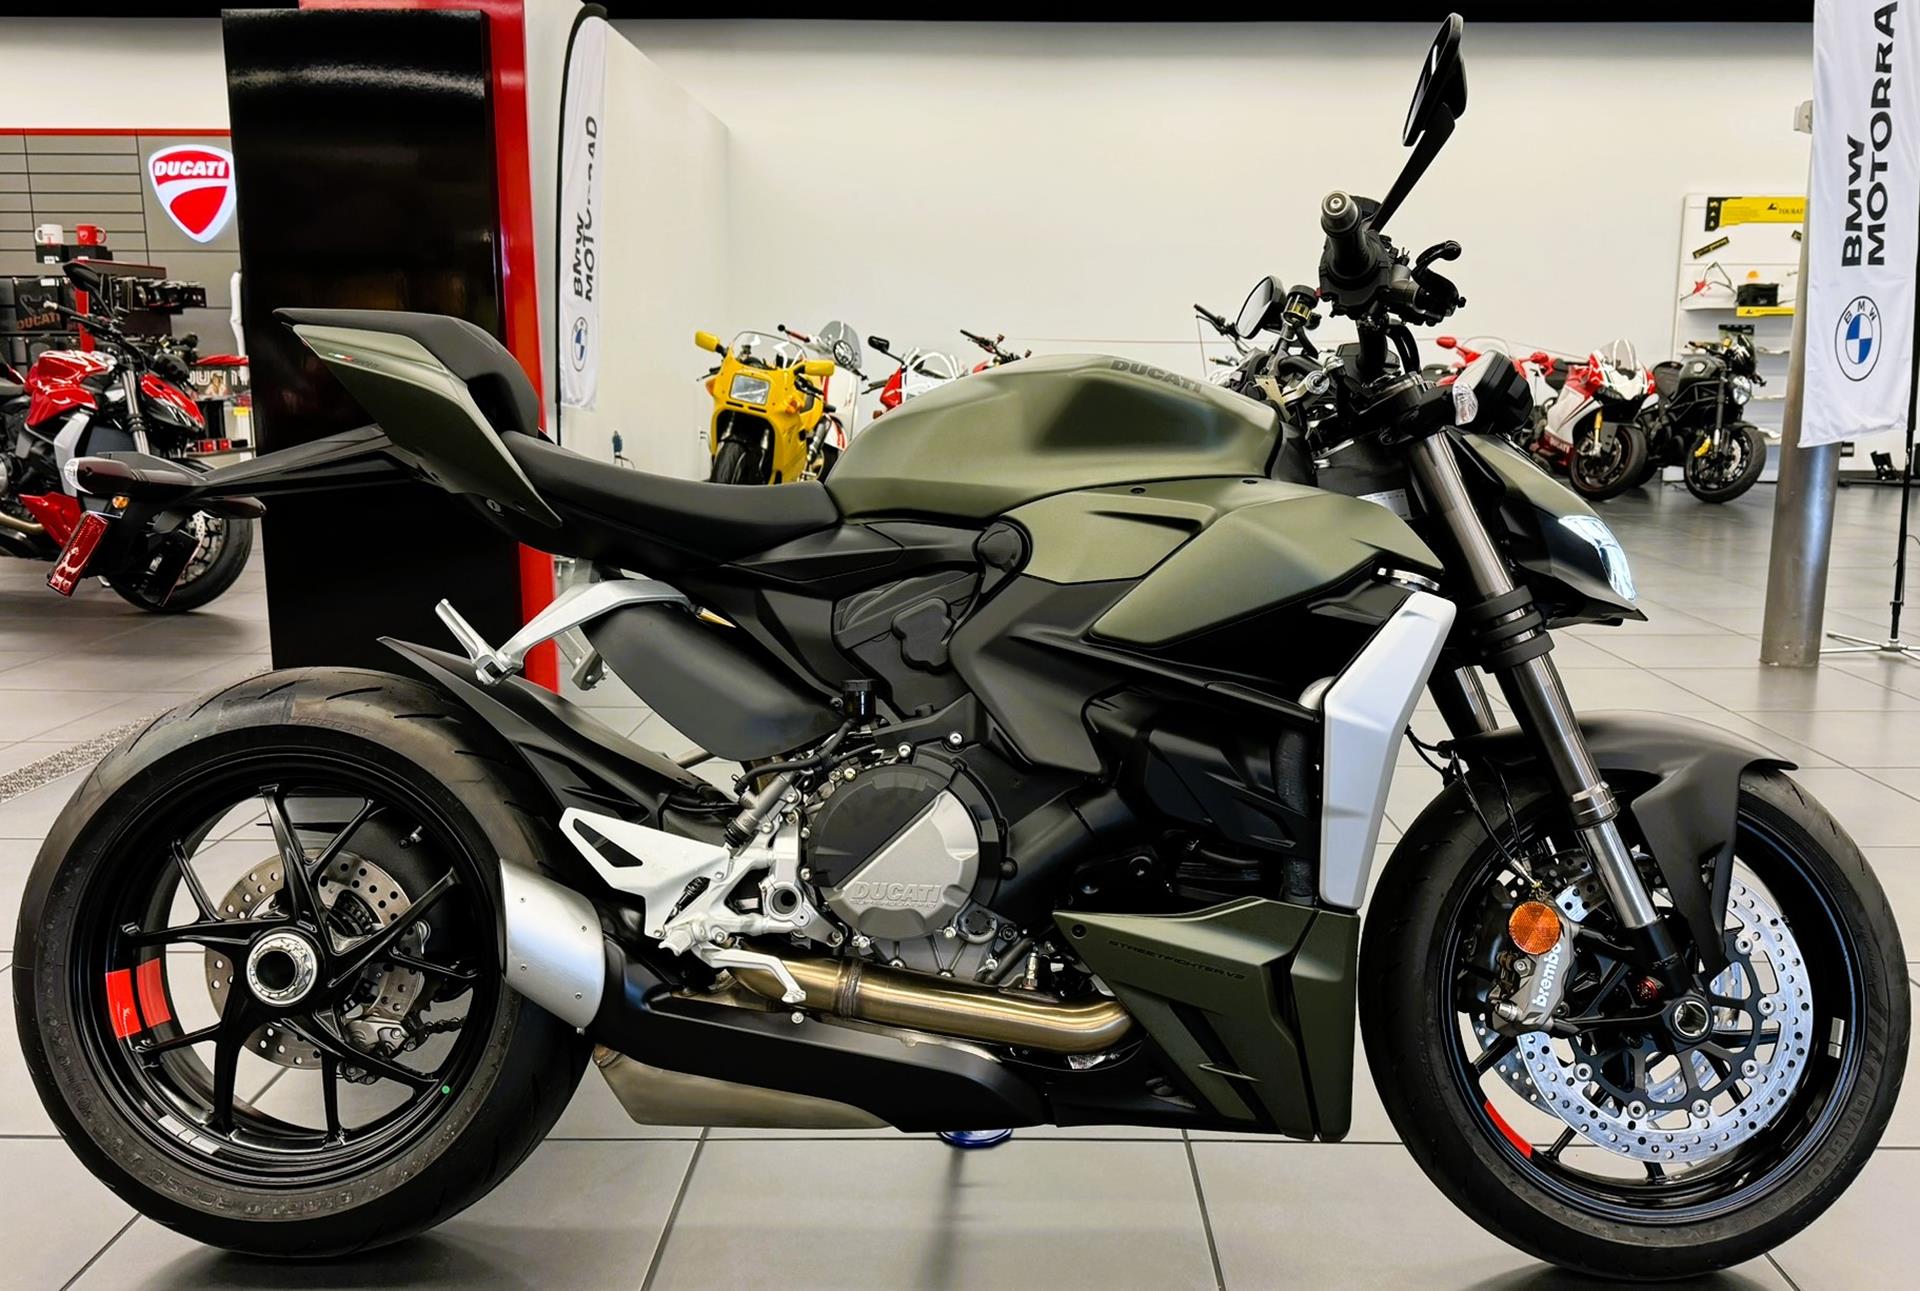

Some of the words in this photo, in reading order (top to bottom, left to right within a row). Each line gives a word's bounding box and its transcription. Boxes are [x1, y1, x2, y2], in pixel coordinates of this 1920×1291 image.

[1867, 2, 1898, 265] MOTORRA
[154, 160, 226, 177] DUCATI
[1842, 134, 1865, 266] BMW
[1844, 300, 1877, 324] BMW
[1110, 359, 1202, 394] DUCATI
[852, 882, 941, 903] DUCATI
[1532, 943, 1562, 1007] brembo
